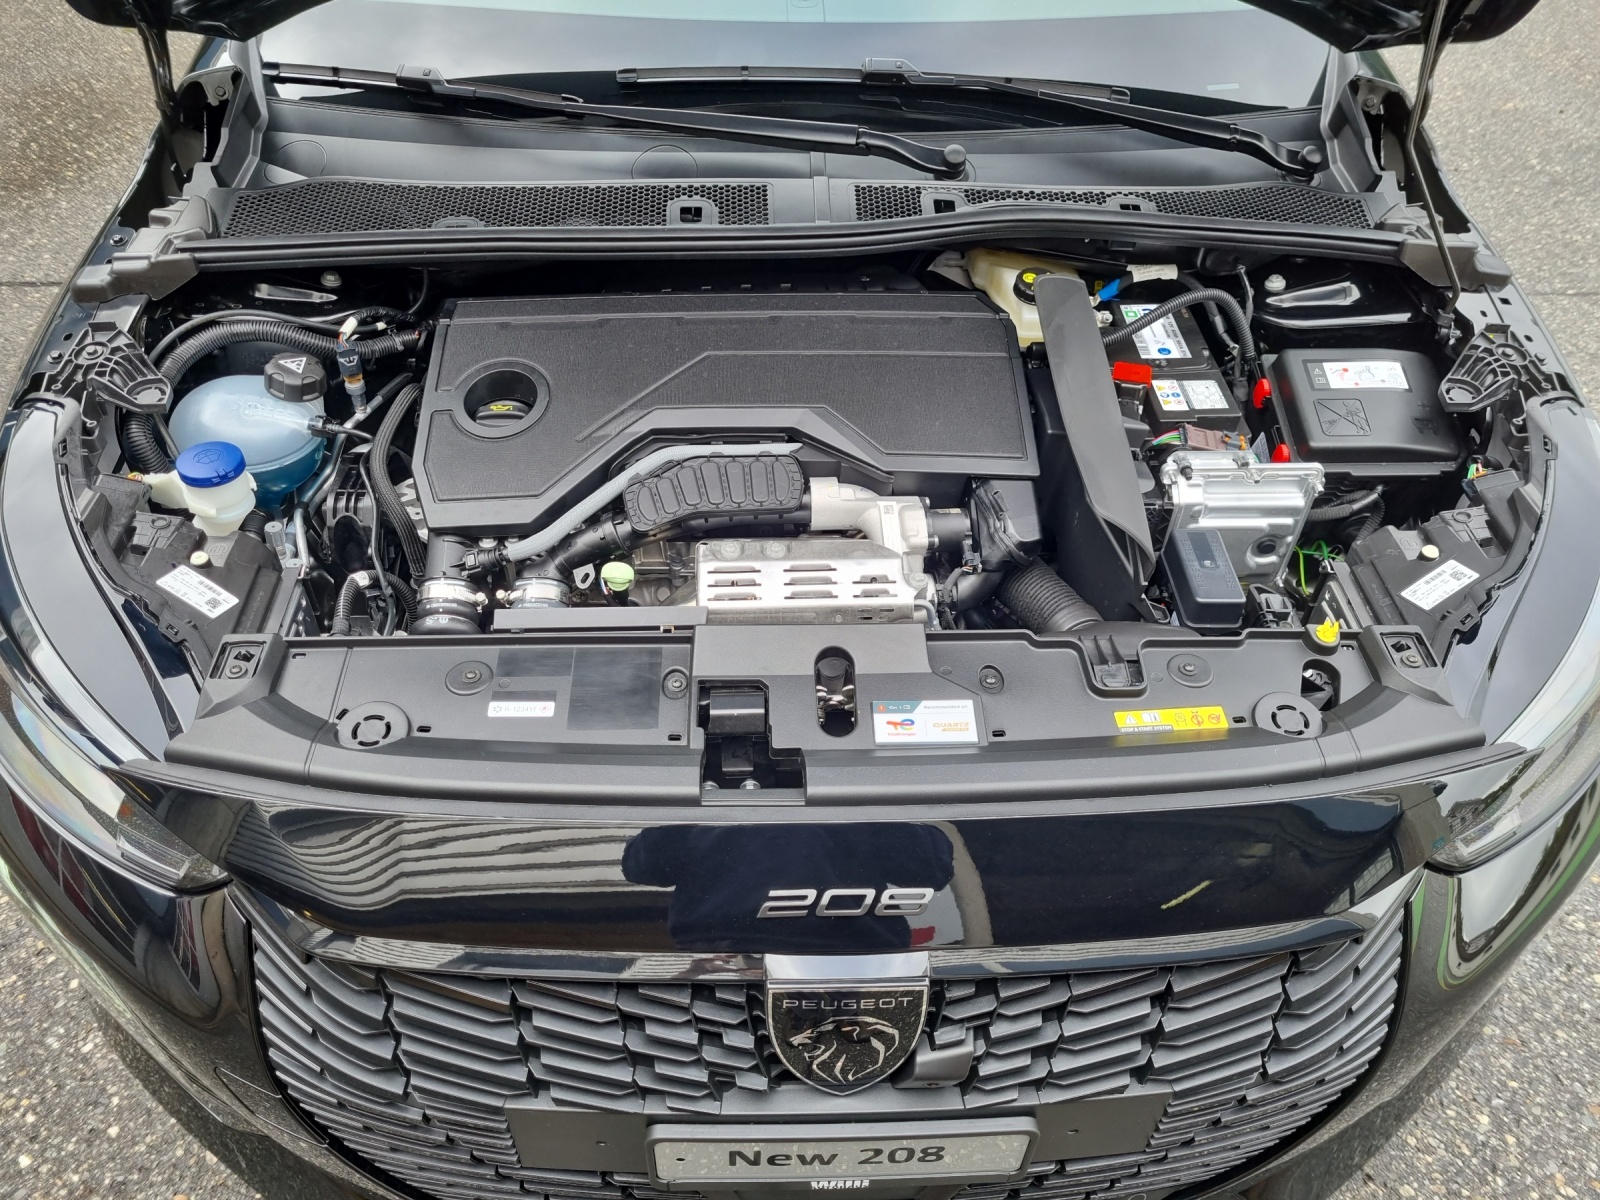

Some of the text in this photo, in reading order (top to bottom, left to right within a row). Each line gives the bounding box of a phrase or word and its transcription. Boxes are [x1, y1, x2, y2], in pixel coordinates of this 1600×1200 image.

[756, 887, 935, 918] 208
[782, 997, 914, 1010] PEUGEOT
[728, 1146, 946, 1167] New 208
